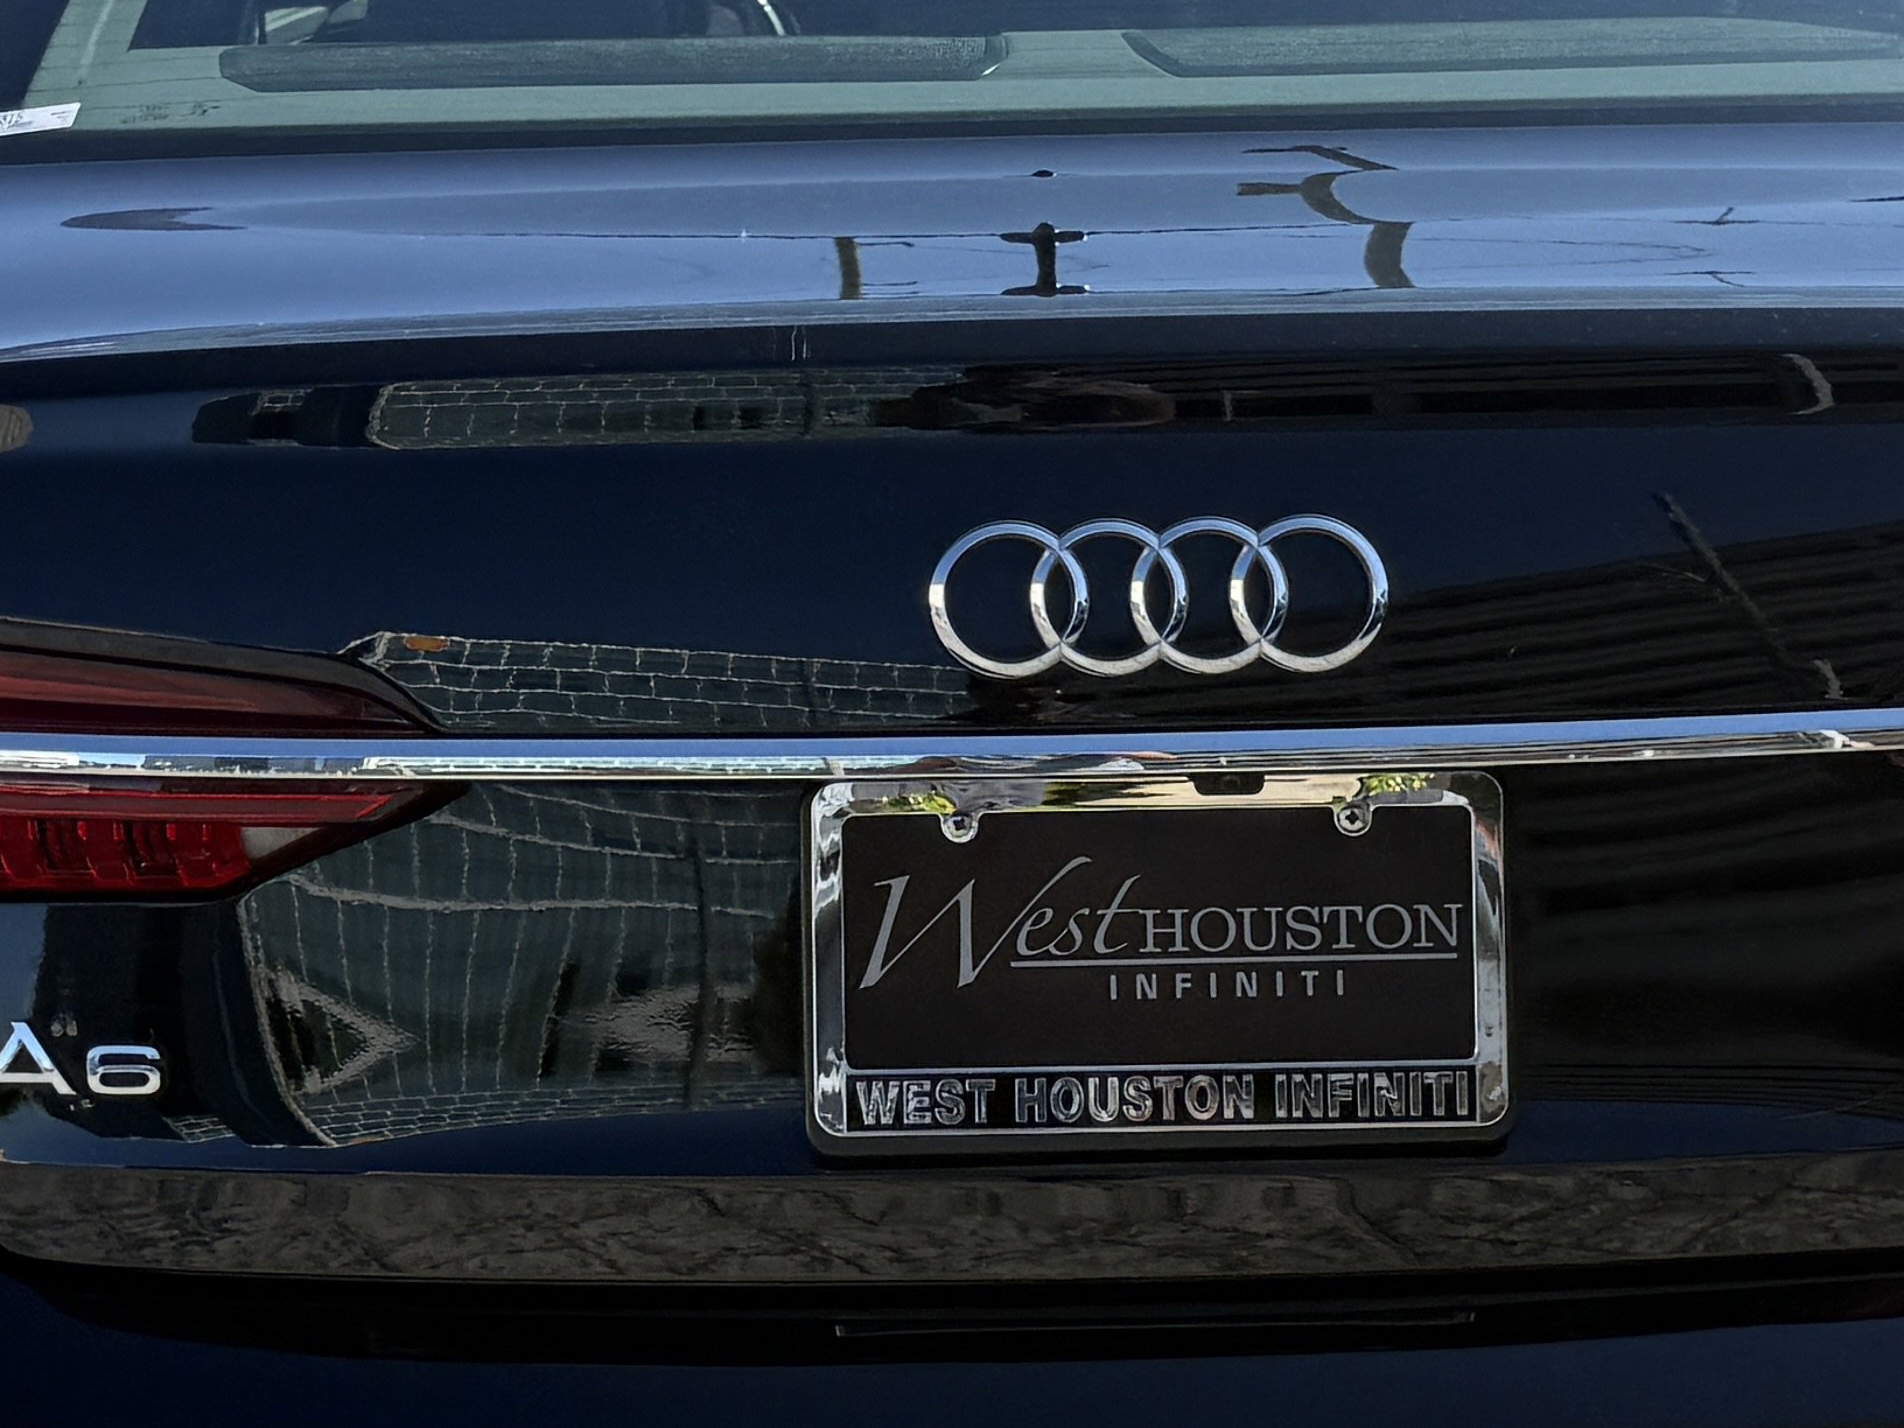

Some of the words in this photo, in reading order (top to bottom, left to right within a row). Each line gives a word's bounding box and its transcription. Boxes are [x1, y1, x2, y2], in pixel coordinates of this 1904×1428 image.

[858, 856, 1141, 990] West
[1138, 902, 1463, 954] HOUSTON
[1109, 969, 1346, 1001] INFINITI
[854, 1077, 997, 1126] WEST
[1014, 1073, 1255, 1123] HOUSTON
[1274, 1070, 1471, 1120] INFINITI
